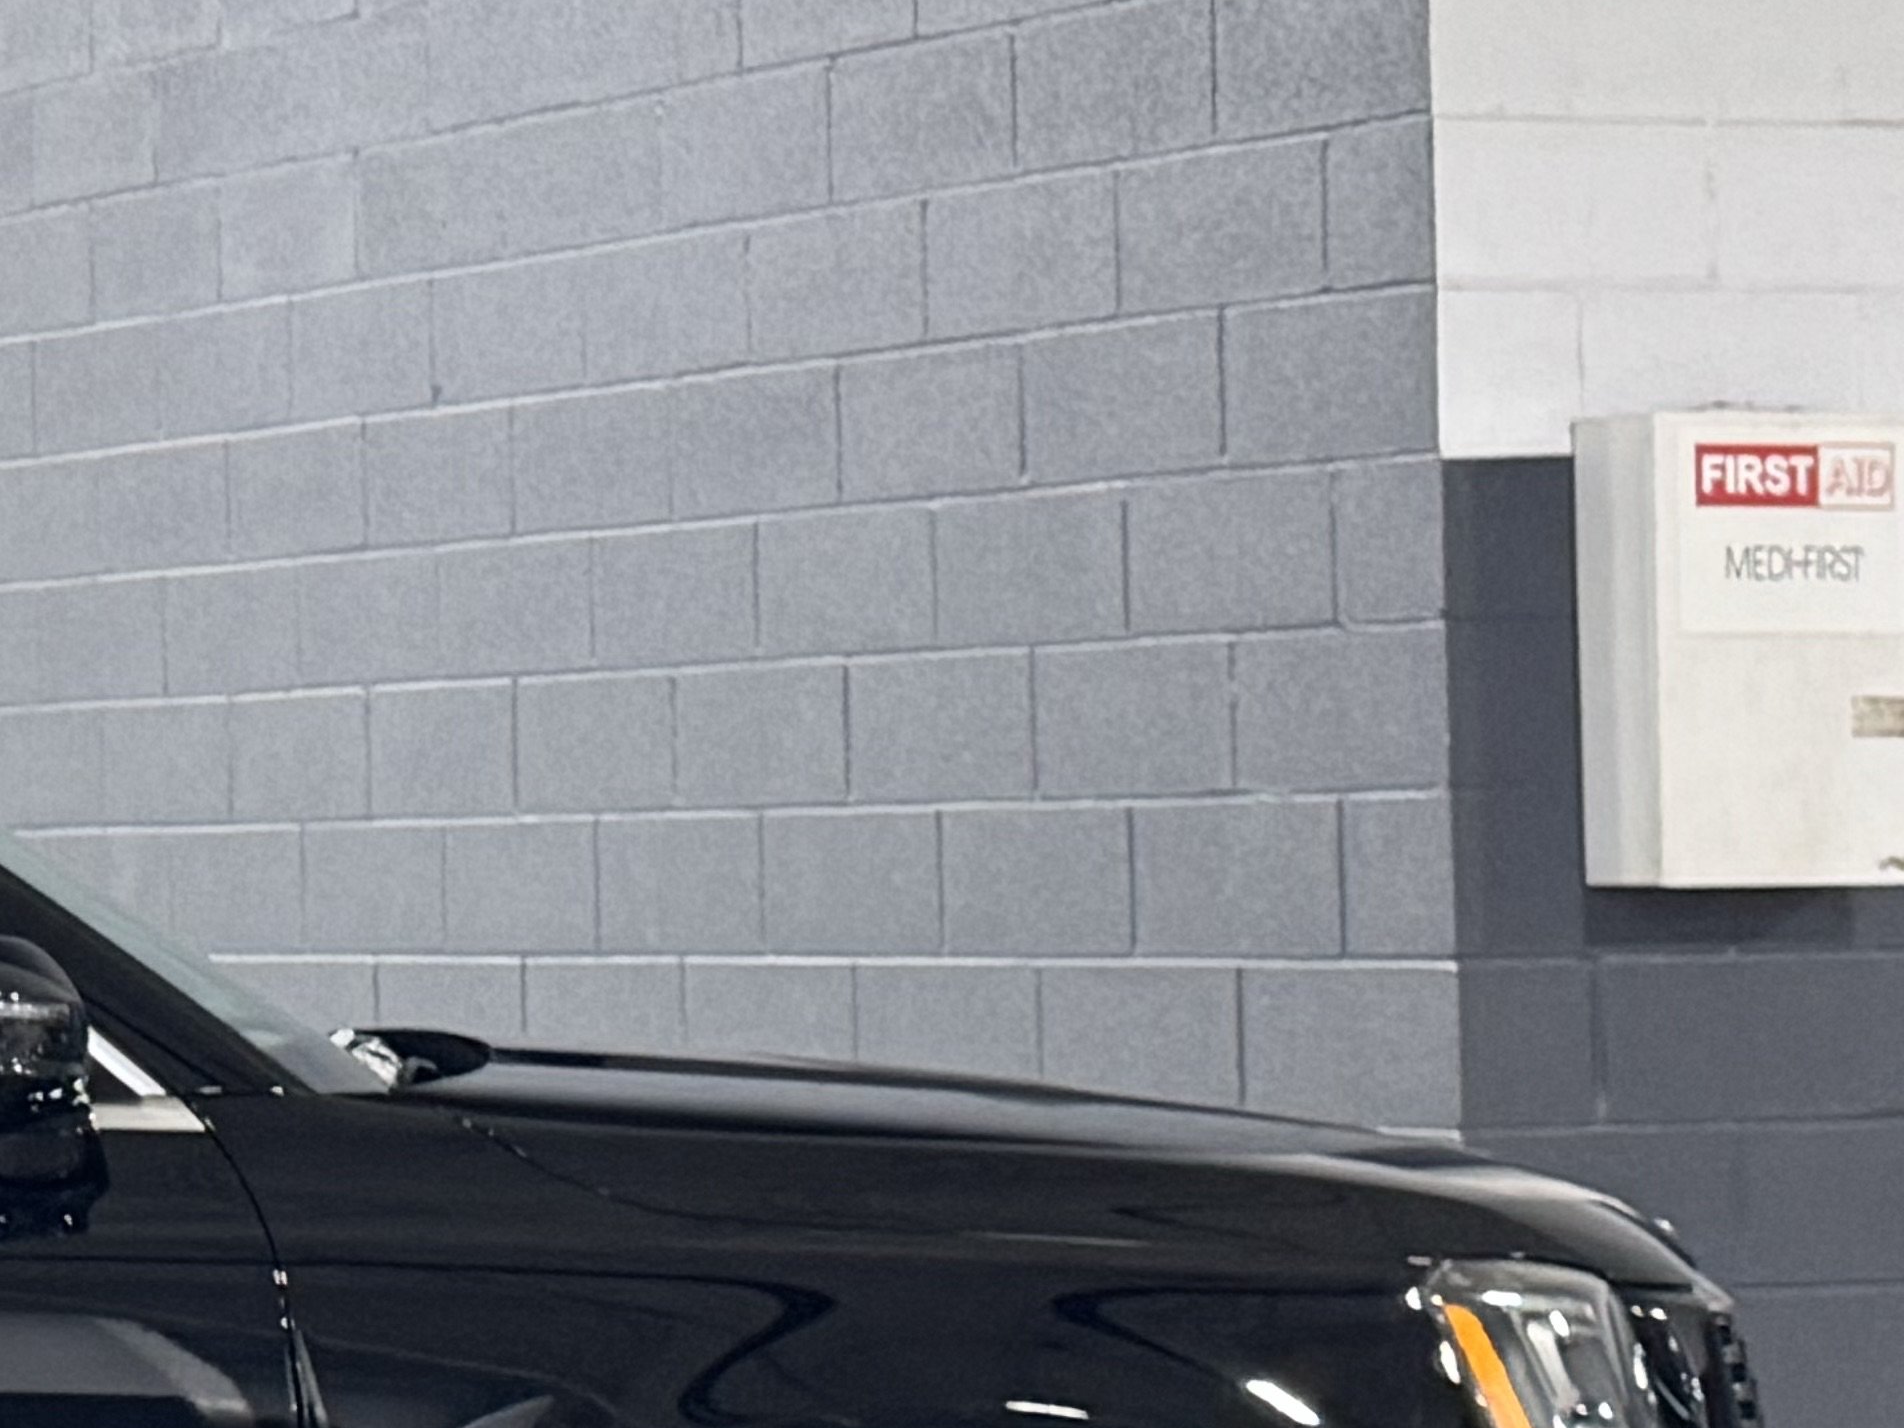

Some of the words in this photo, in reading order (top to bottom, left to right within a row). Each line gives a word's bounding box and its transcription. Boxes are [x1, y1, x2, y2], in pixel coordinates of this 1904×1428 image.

[1700, 453, 1815, 497] FIRST
[1825, 454, 1891, 497] AID
[1724, 544, 1865, 583] MEDI-FIRST
